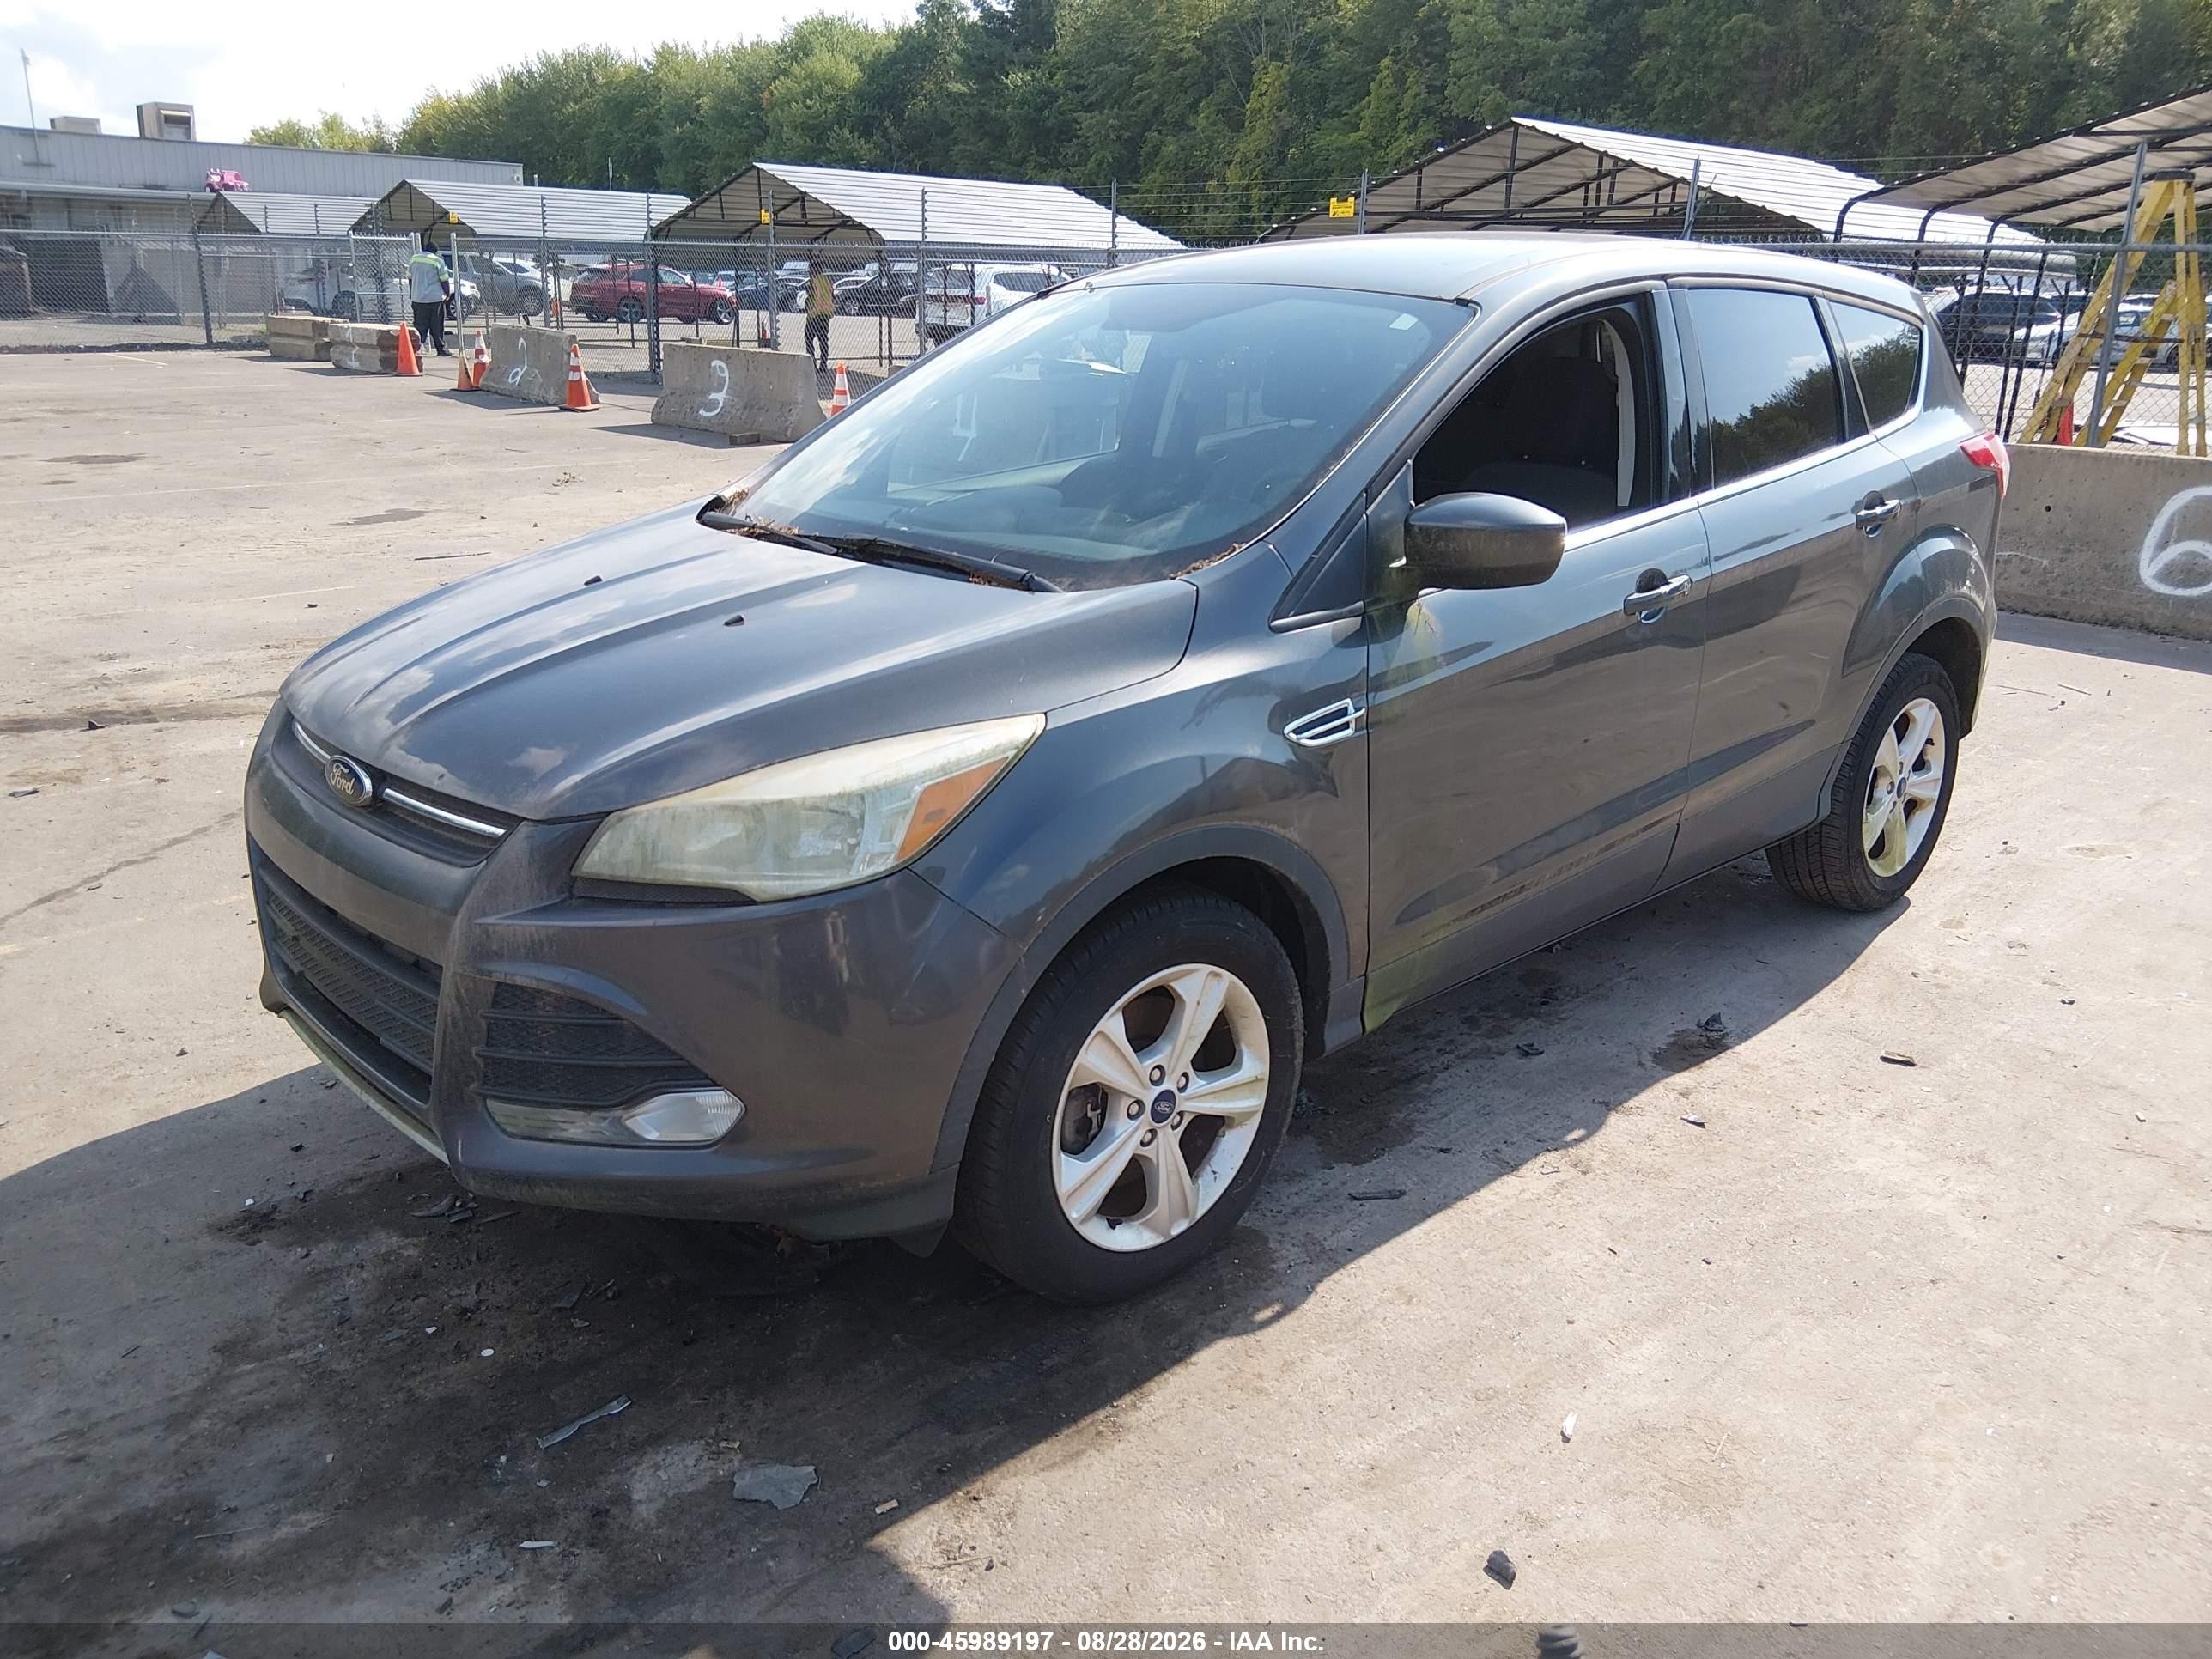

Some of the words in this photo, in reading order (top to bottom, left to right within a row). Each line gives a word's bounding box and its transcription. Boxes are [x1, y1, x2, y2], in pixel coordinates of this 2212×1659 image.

[698, 359, 729, 417] 3
[2138, 485, 2212, 597] 6
[331, 763, 355, 794] Ford
